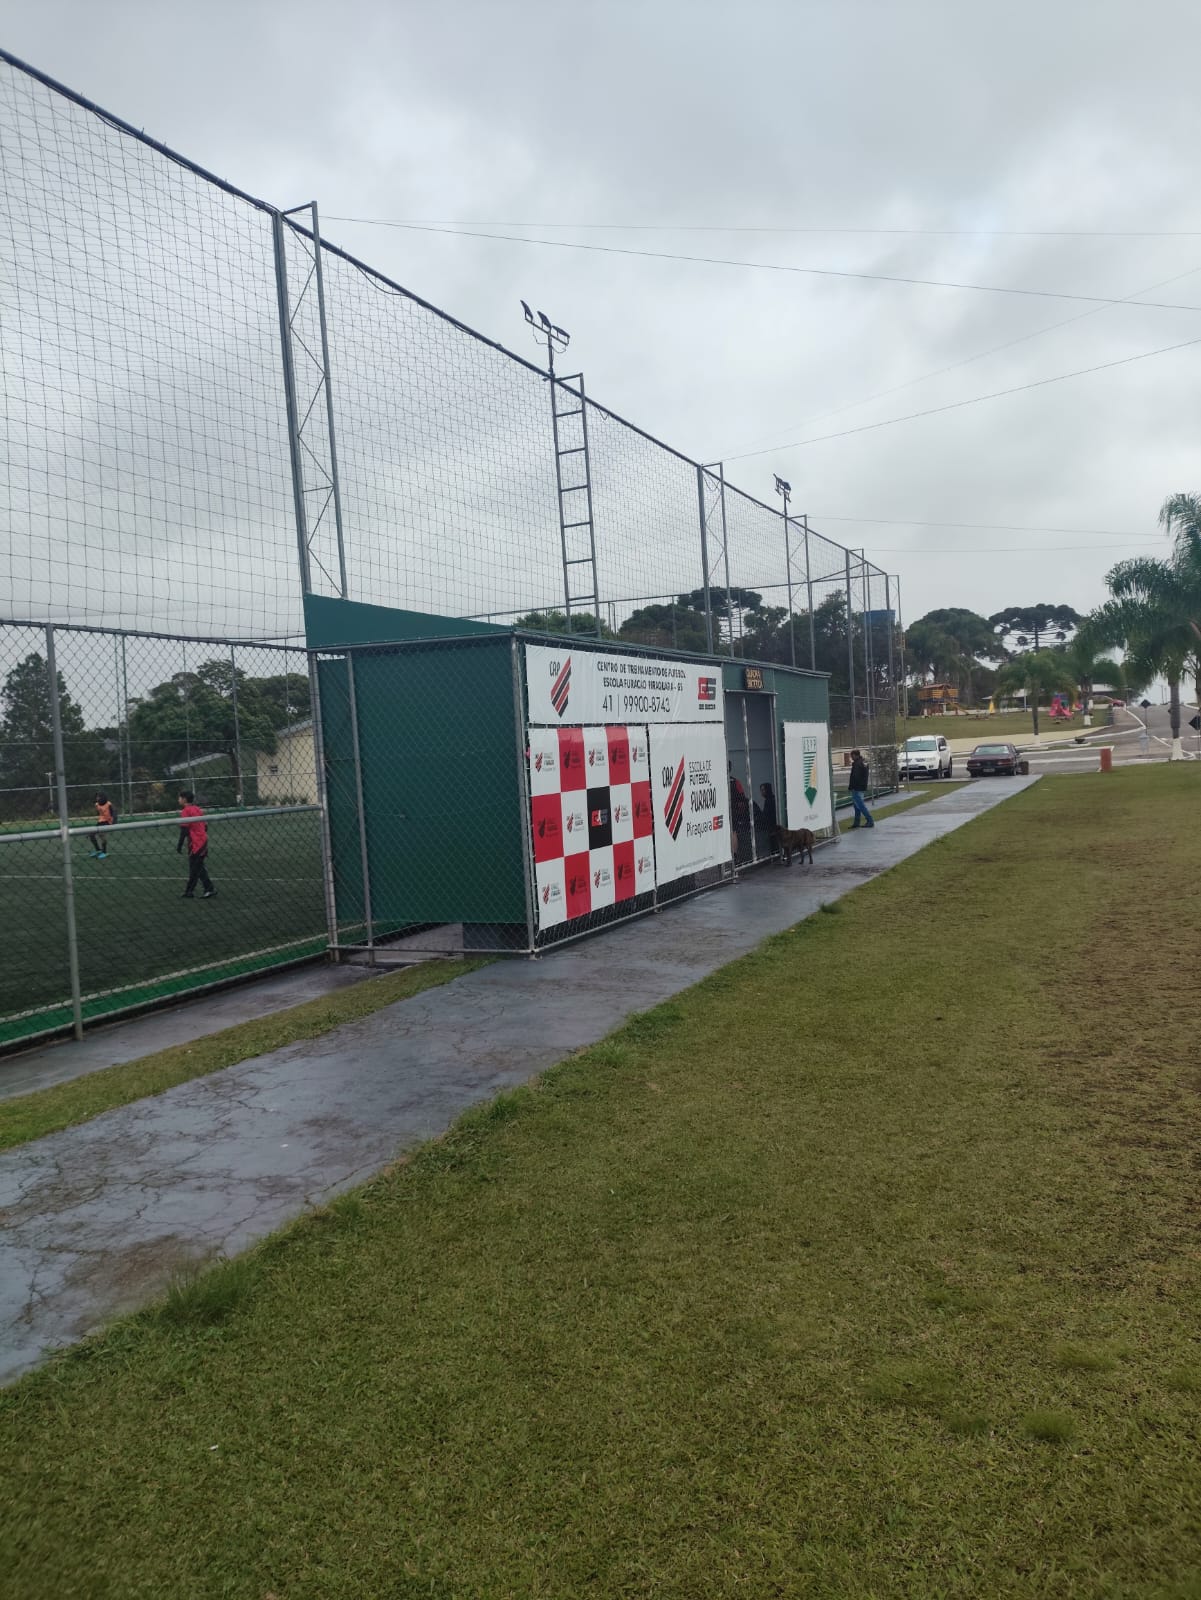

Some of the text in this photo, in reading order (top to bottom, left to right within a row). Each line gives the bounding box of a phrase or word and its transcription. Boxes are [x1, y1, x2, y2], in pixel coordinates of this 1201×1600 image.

[597, 661, 619, 672] CENTRO
[620, 664, 627, 674] DE
[604, 678, 624, 688] ESCOLA
[603, 695, 671, 712] 41 99900-8743
[690, 760, 712, 773] ESCOLA DE
[662, 767, 674, 788] CAP
[690, 774, 710, 785] FUTEBOL
[687, 820, 712, 837] Piraquara
